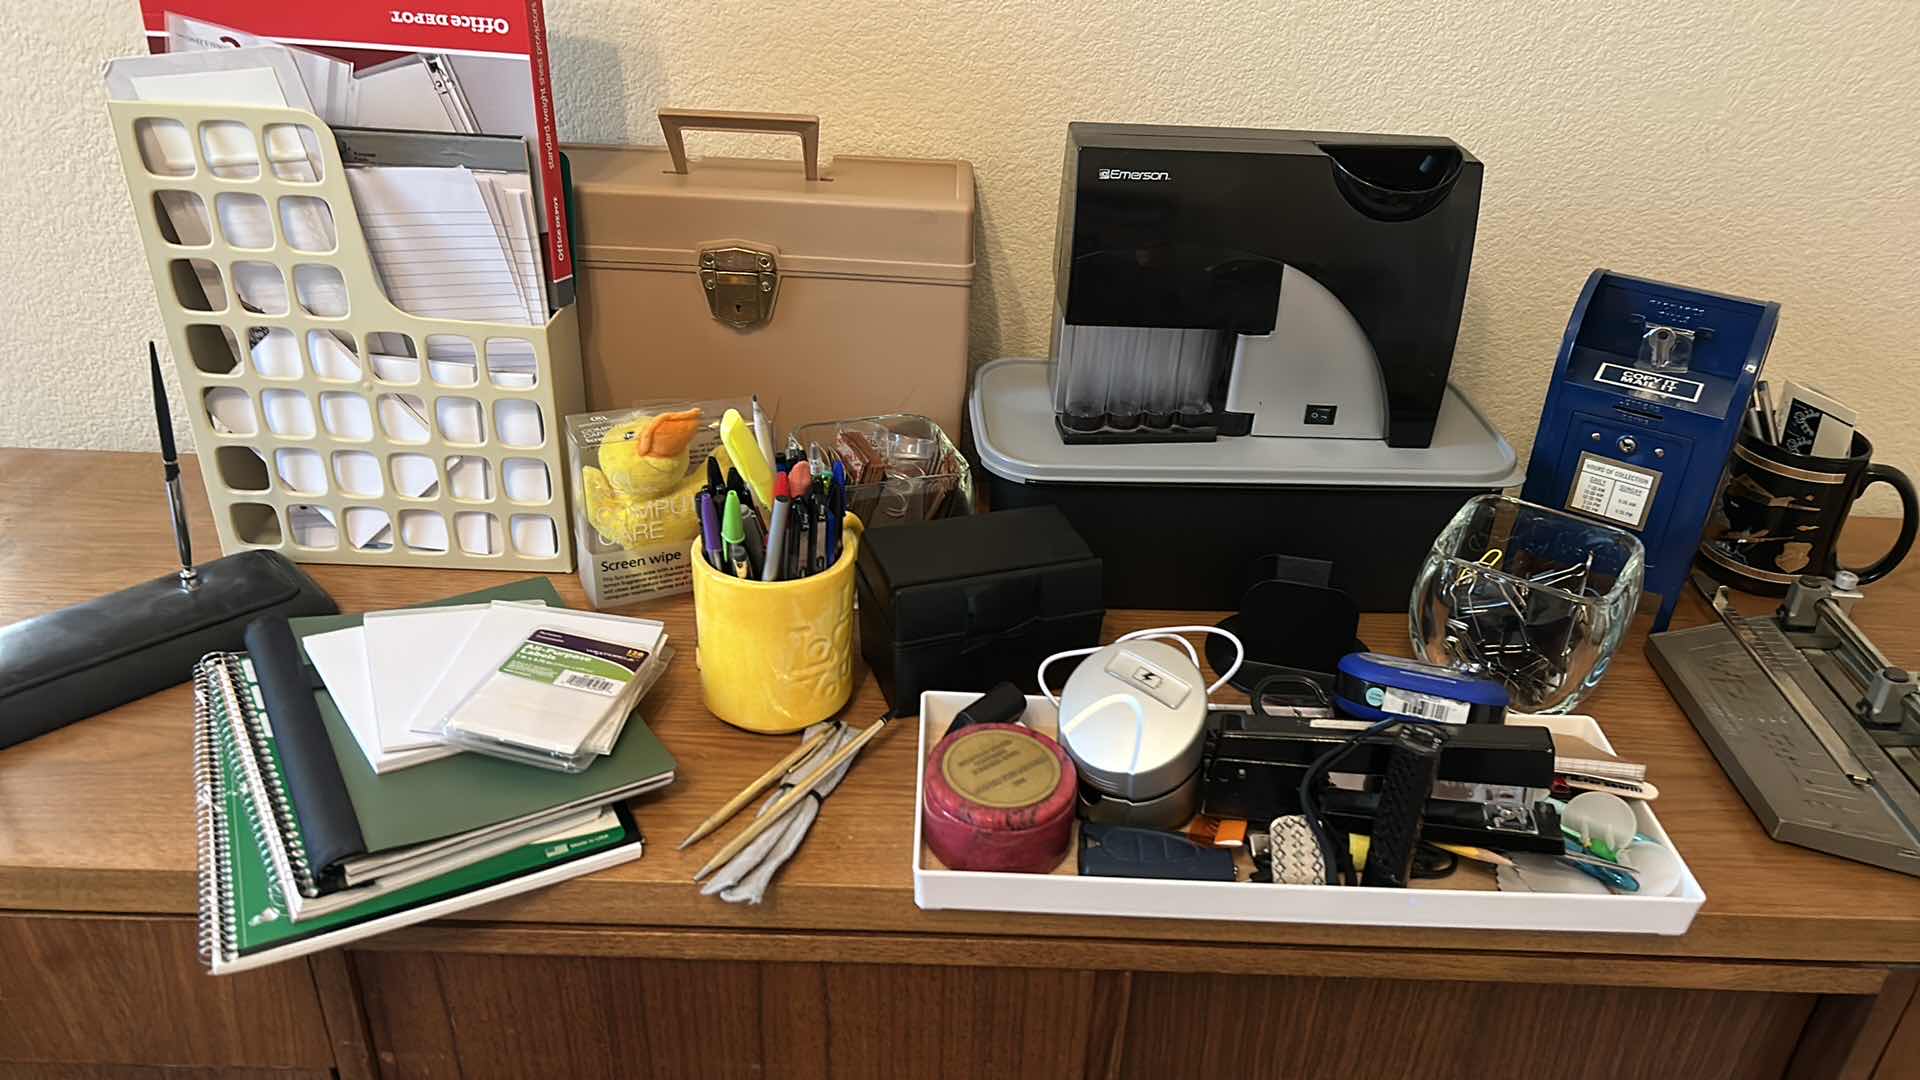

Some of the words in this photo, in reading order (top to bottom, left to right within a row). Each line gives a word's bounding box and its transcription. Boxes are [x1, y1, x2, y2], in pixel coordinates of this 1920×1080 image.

[390, 11, 449, 26] DEPOT
[450, 14, 509, 34] Office
[530, 2, 543, 55] protectors
[535, 58, 546, 86] sheet
[540, 86, 550, 124] weight
[543, 125, 554, 169] standard
[1110, 169, 1168, 180] Emerson
[557, 229, 565, 261] Office
[1620, 376, 1657, 389] MAIL
[1622, 371, 1662, 383] COPY
[601, 557, 646, 572] Screen
[648, 551, 682, 565] wipe
[520, 648, 557, 661] Labels
[523, 644, 593, 663] All-Purpose
